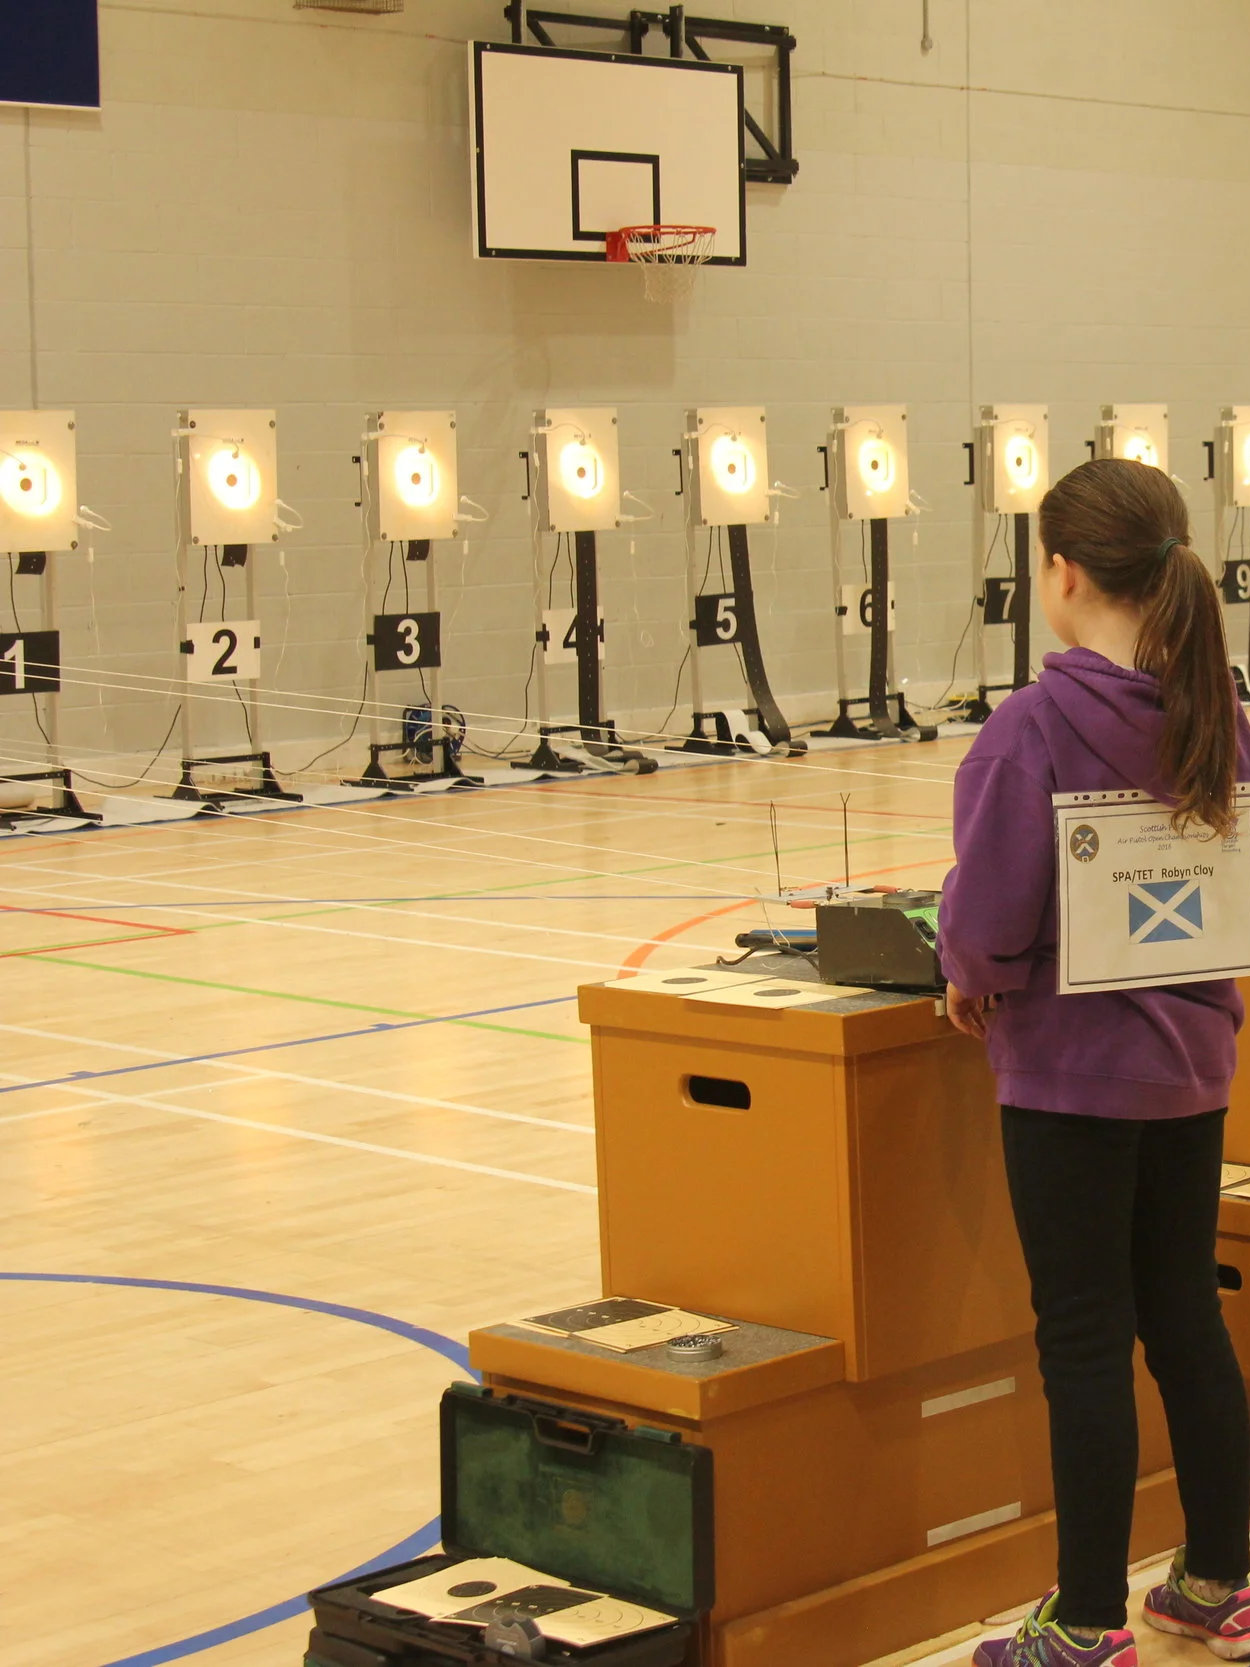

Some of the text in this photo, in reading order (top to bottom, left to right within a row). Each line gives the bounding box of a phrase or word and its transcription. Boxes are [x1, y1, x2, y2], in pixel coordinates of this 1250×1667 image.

[999, 581, 1016, 620] 7
[1236, 563, 1250, 600] 9
[715, 597, 738, 641] 5
[211, 628, 238, 676] 2
[396, 618, 421, 665] 3
[3, 639, 25, 690] 1
[1112, 864, 1215, 884] SPA/TET Robyn Cloy
